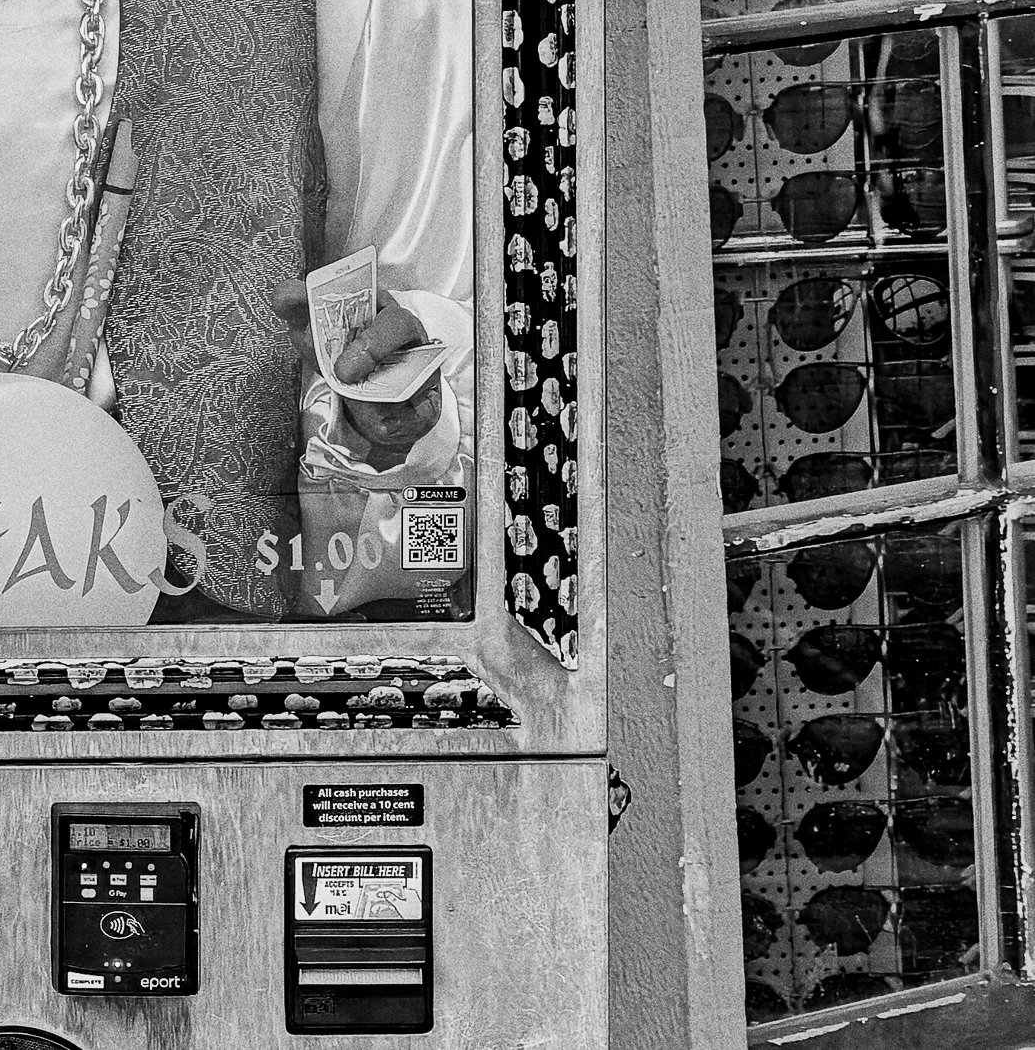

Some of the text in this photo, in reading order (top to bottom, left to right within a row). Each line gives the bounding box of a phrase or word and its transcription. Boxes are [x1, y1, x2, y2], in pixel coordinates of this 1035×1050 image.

[420, 490, 459, 499] SCAN ME
[254, 528, 384, 576] $1.00
[318, 788, 410, 800] All cash purchases
[312, 800, 331, 810] will
[332, 800, 369, 810] receive
[378, 800, 392, 809] 10
[392, 800, 415, 809] cent
[318, 812, 410, 824] discount per item.
[311, 862, 407, 878] INSERT BILL HERE
[325, 900, 351, 916] mei
[140, 975, 181, 991] eport
